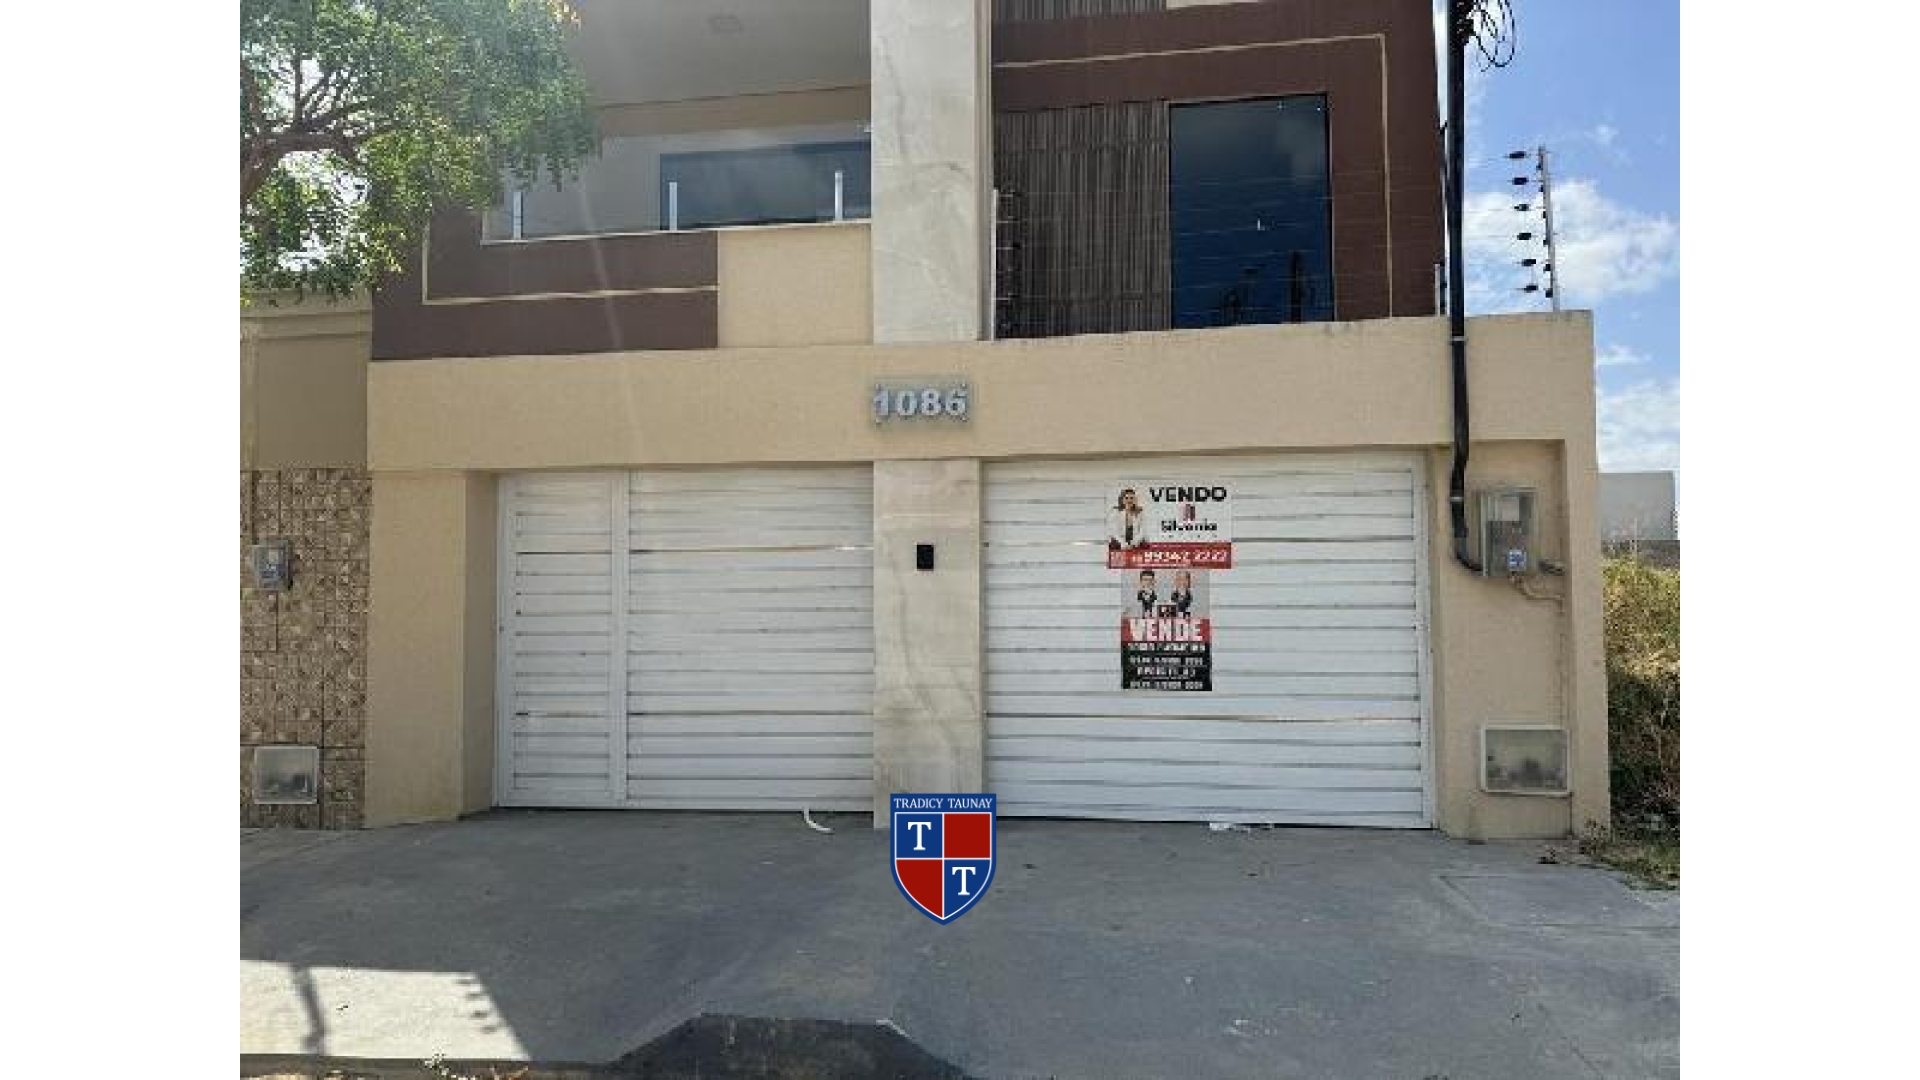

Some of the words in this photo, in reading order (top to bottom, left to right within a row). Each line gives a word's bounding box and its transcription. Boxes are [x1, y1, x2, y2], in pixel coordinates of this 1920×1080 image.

[873, 387, 967, 416] 1086
[1149, 486, 1227, 502] VENDO
[1129, 618, 1204, 642] VENDE
